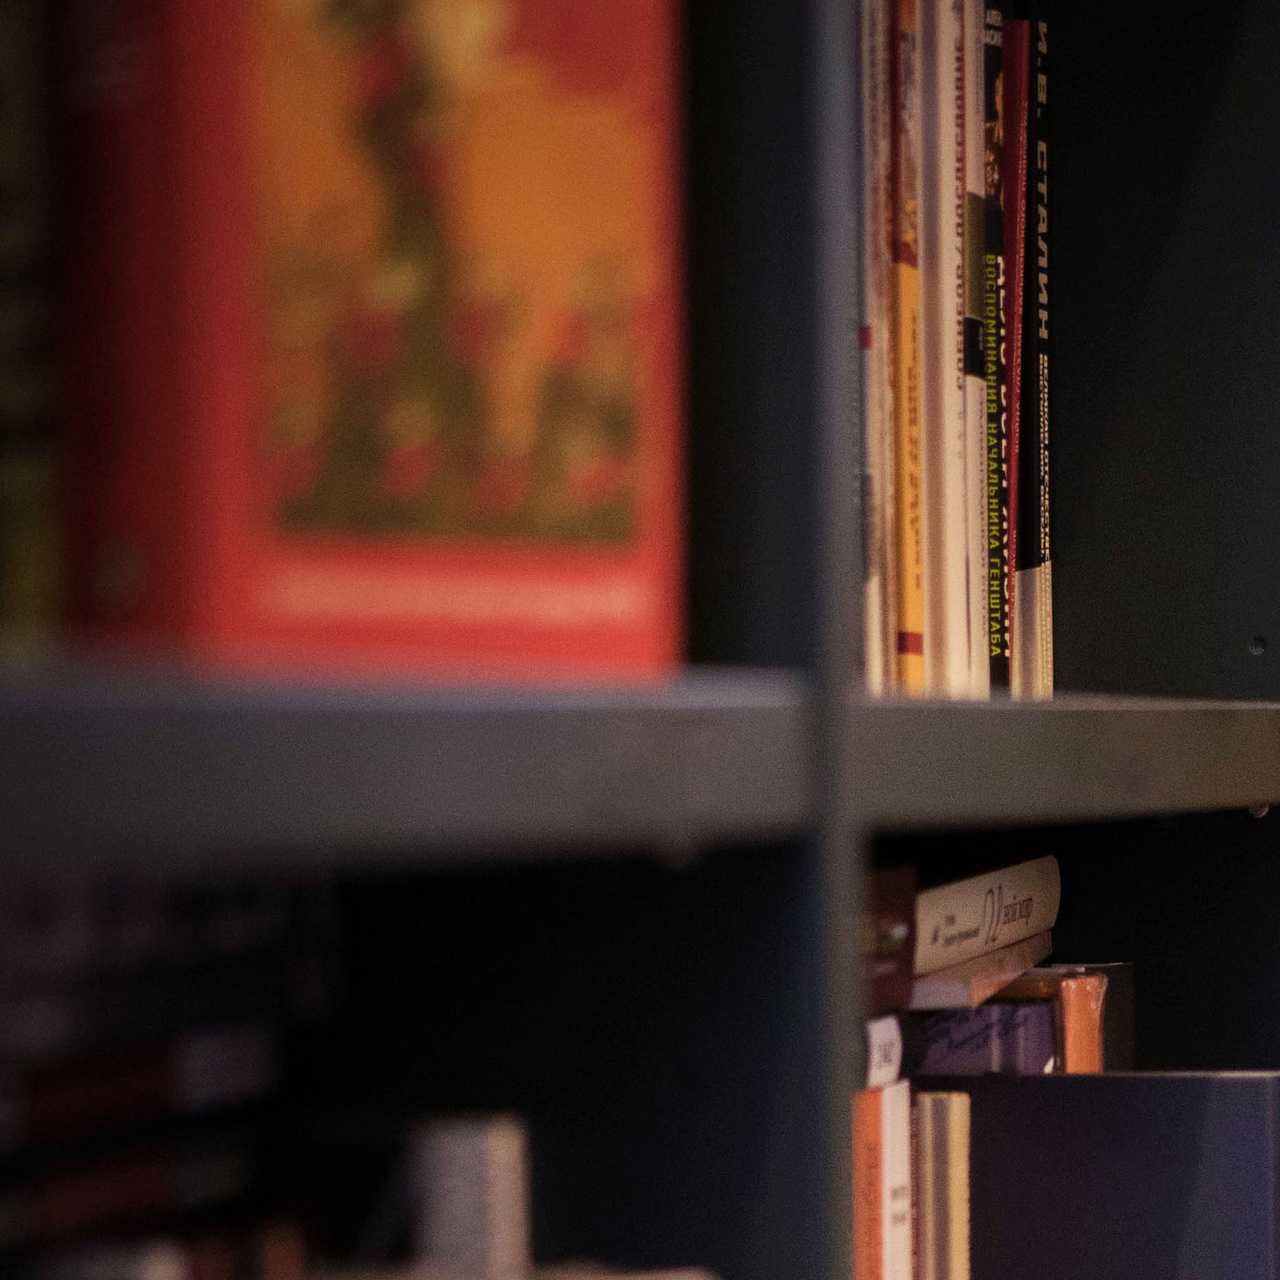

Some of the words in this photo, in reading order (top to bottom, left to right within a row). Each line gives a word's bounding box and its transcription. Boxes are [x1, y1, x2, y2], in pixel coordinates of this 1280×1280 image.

[1037, 139, 1049, 340] СТАЛИН
[986, 254, 998, 414] ВОСПОМИНАНИЯ
[987, 422, 1000, 549] НАЧАЛЬНИКА
[990, 557, 1002, 657] ГЕНШТАБА
